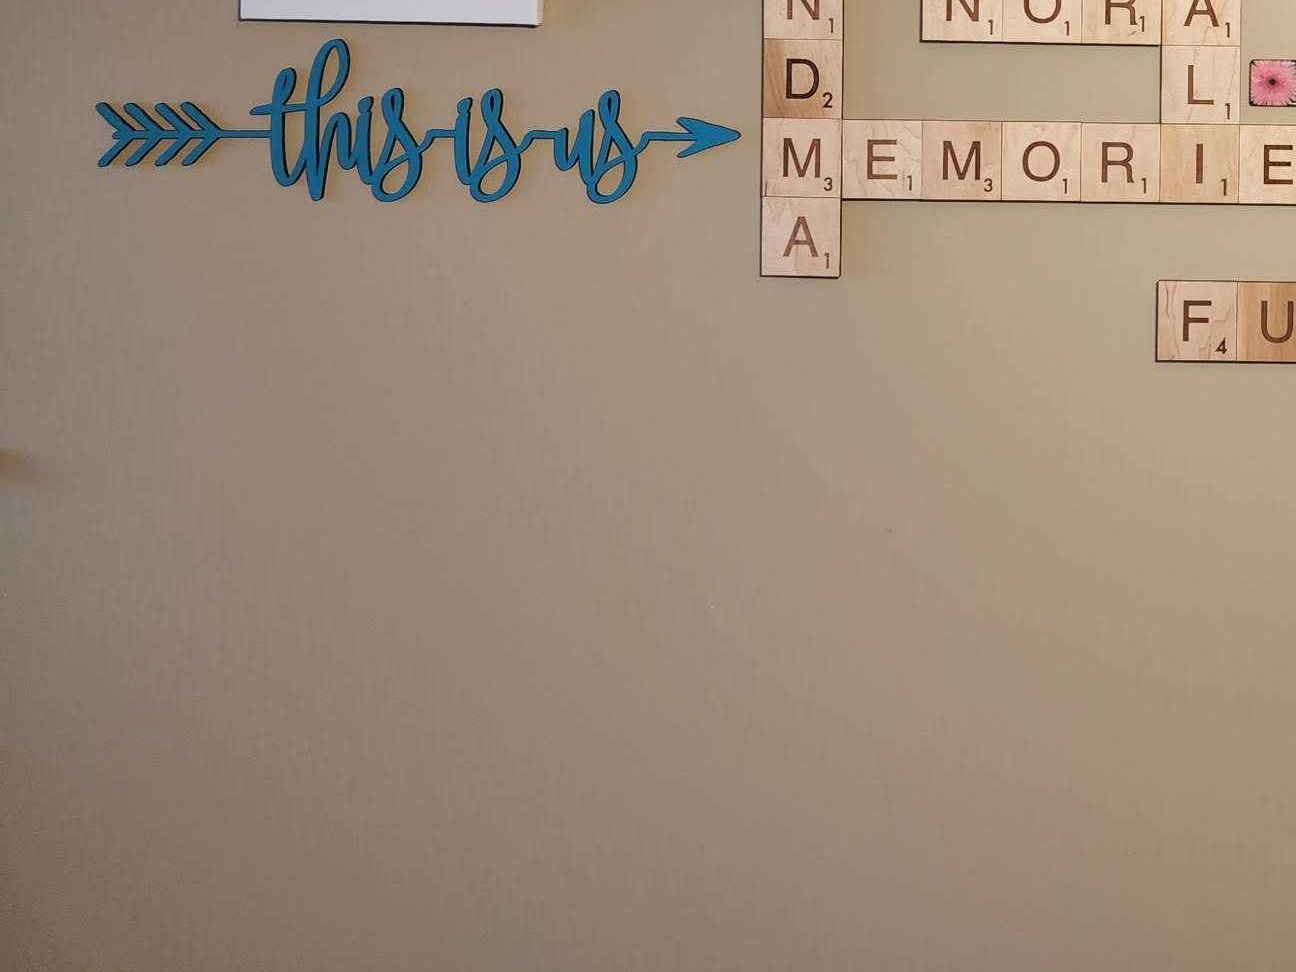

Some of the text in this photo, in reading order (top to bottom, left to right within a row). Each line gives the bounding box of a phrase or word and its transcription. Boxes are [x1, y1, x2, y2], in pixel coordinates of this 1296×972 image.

[250, 38, 641, 204] this is us
